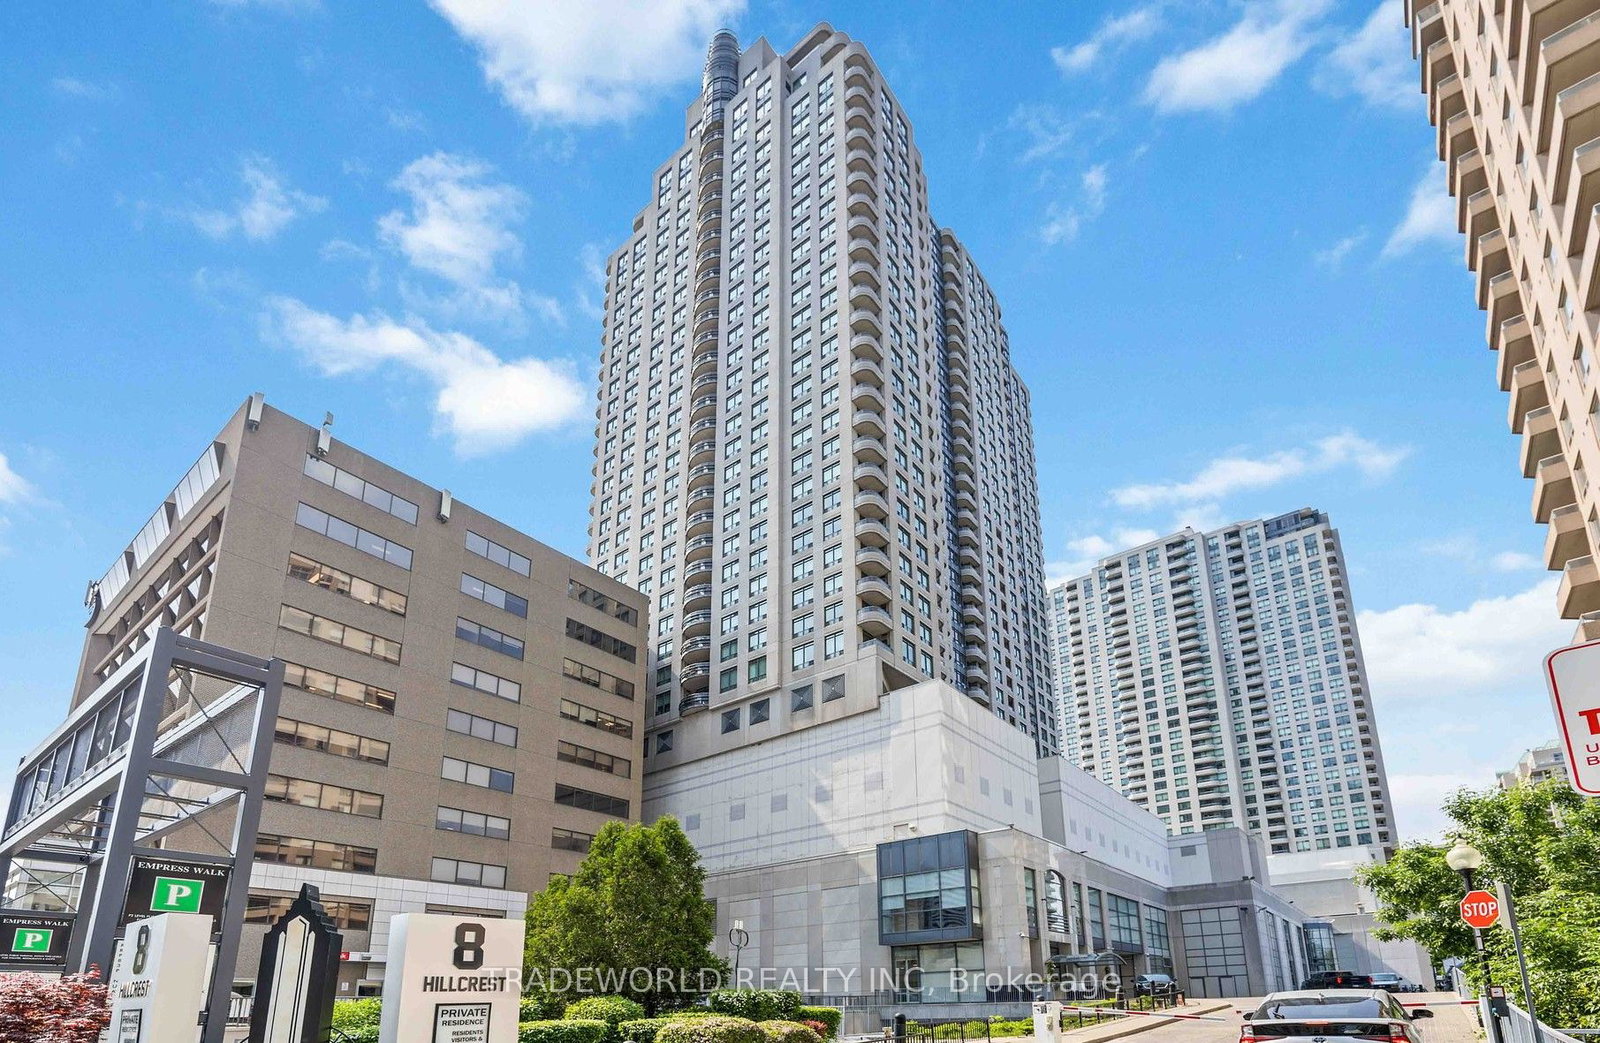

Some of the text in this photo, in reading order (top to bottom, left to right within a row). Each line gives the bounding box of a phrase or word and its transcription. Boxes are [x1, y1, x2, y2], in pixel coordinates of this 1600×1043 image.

[137, 861, 225, 877] EMPRESS WALK
[164, 883, 192, 906] P
[1464, 902, 1497, 917] STOP
[22, 932, 44, 948] P
[453, 922, 486, 970] 8
[132, 925, 150, 975] 8
[119, 980, 150, 999] HILLCREST
[423, 976, 507, 992] HILLCREST
[441, 1008, 488, 1018] PRIVATE
[442, 1018, 484, 1027] RESIDENCE
